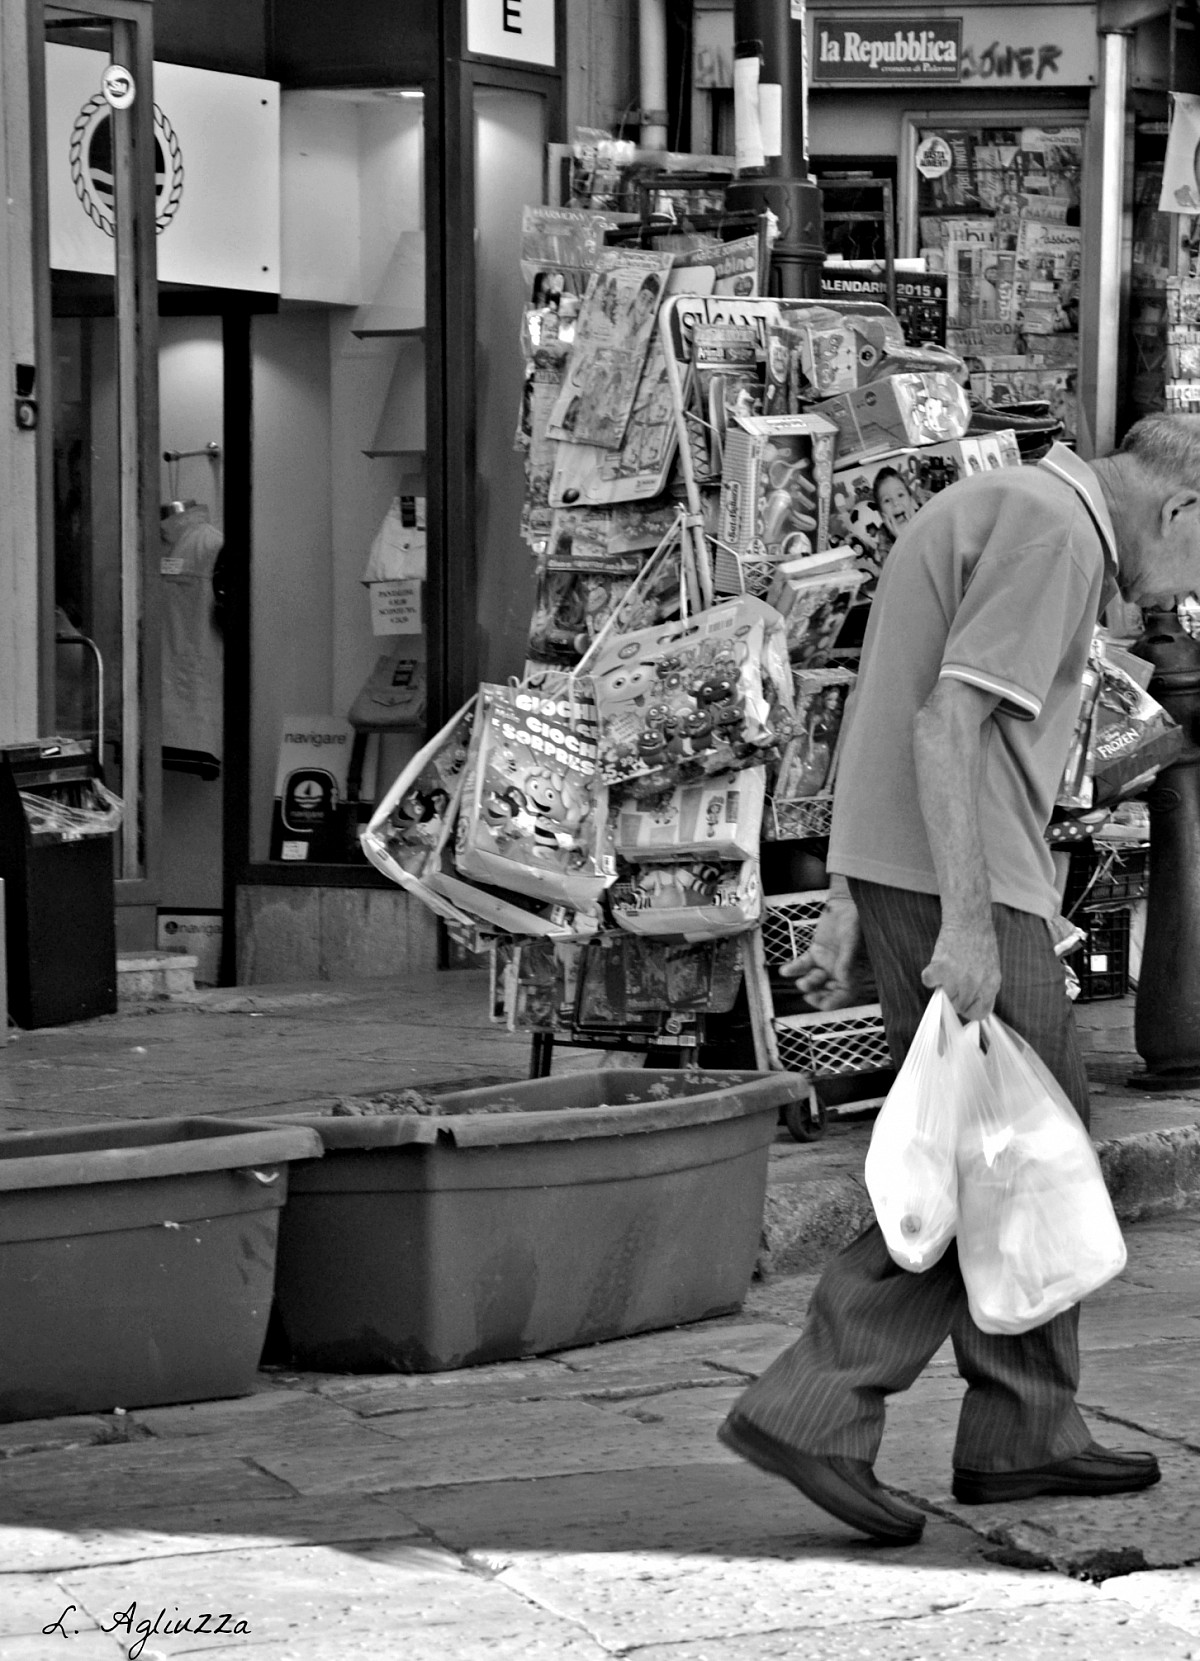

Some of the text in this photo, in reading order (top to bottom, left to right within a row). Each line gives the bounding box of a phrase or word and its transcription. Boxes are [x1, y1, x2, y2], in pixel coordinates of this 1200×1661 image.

[503, 0, 522, 34] E
[819, 31, 957, 68] la Repubblica
[821, 279, 931, 297] ALENDARI 2015
[502, 722, 597, 776] SORPRES
[1097, 727, 1140, 759] FROZEN
[180, 923, 224, 937] naviga
